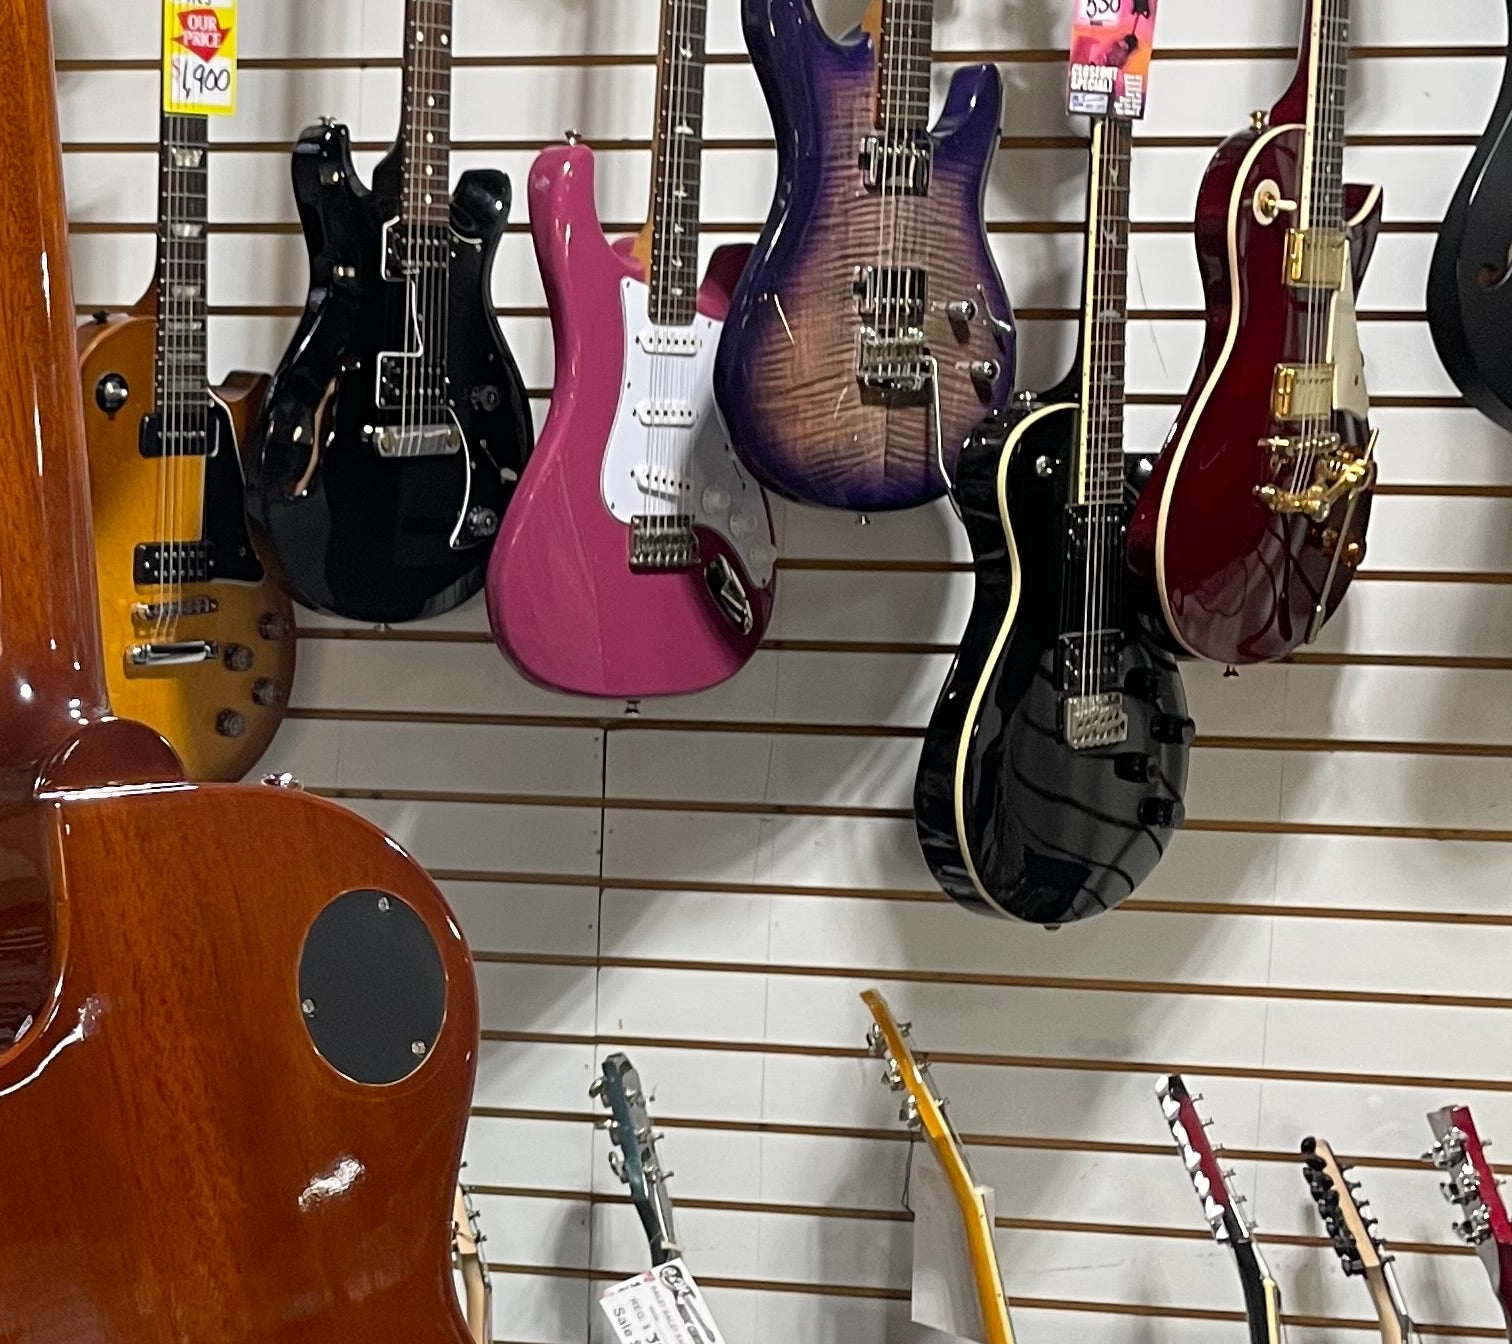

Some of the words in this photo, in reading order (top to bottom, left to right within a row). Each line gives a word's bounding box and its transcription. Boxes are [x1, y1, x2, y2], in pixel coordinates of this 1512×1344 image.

[187, 14, 217, 32] OUR
[182, 31, 223, 48] PRICE
[614, 1307, 633, 1338] Sale
